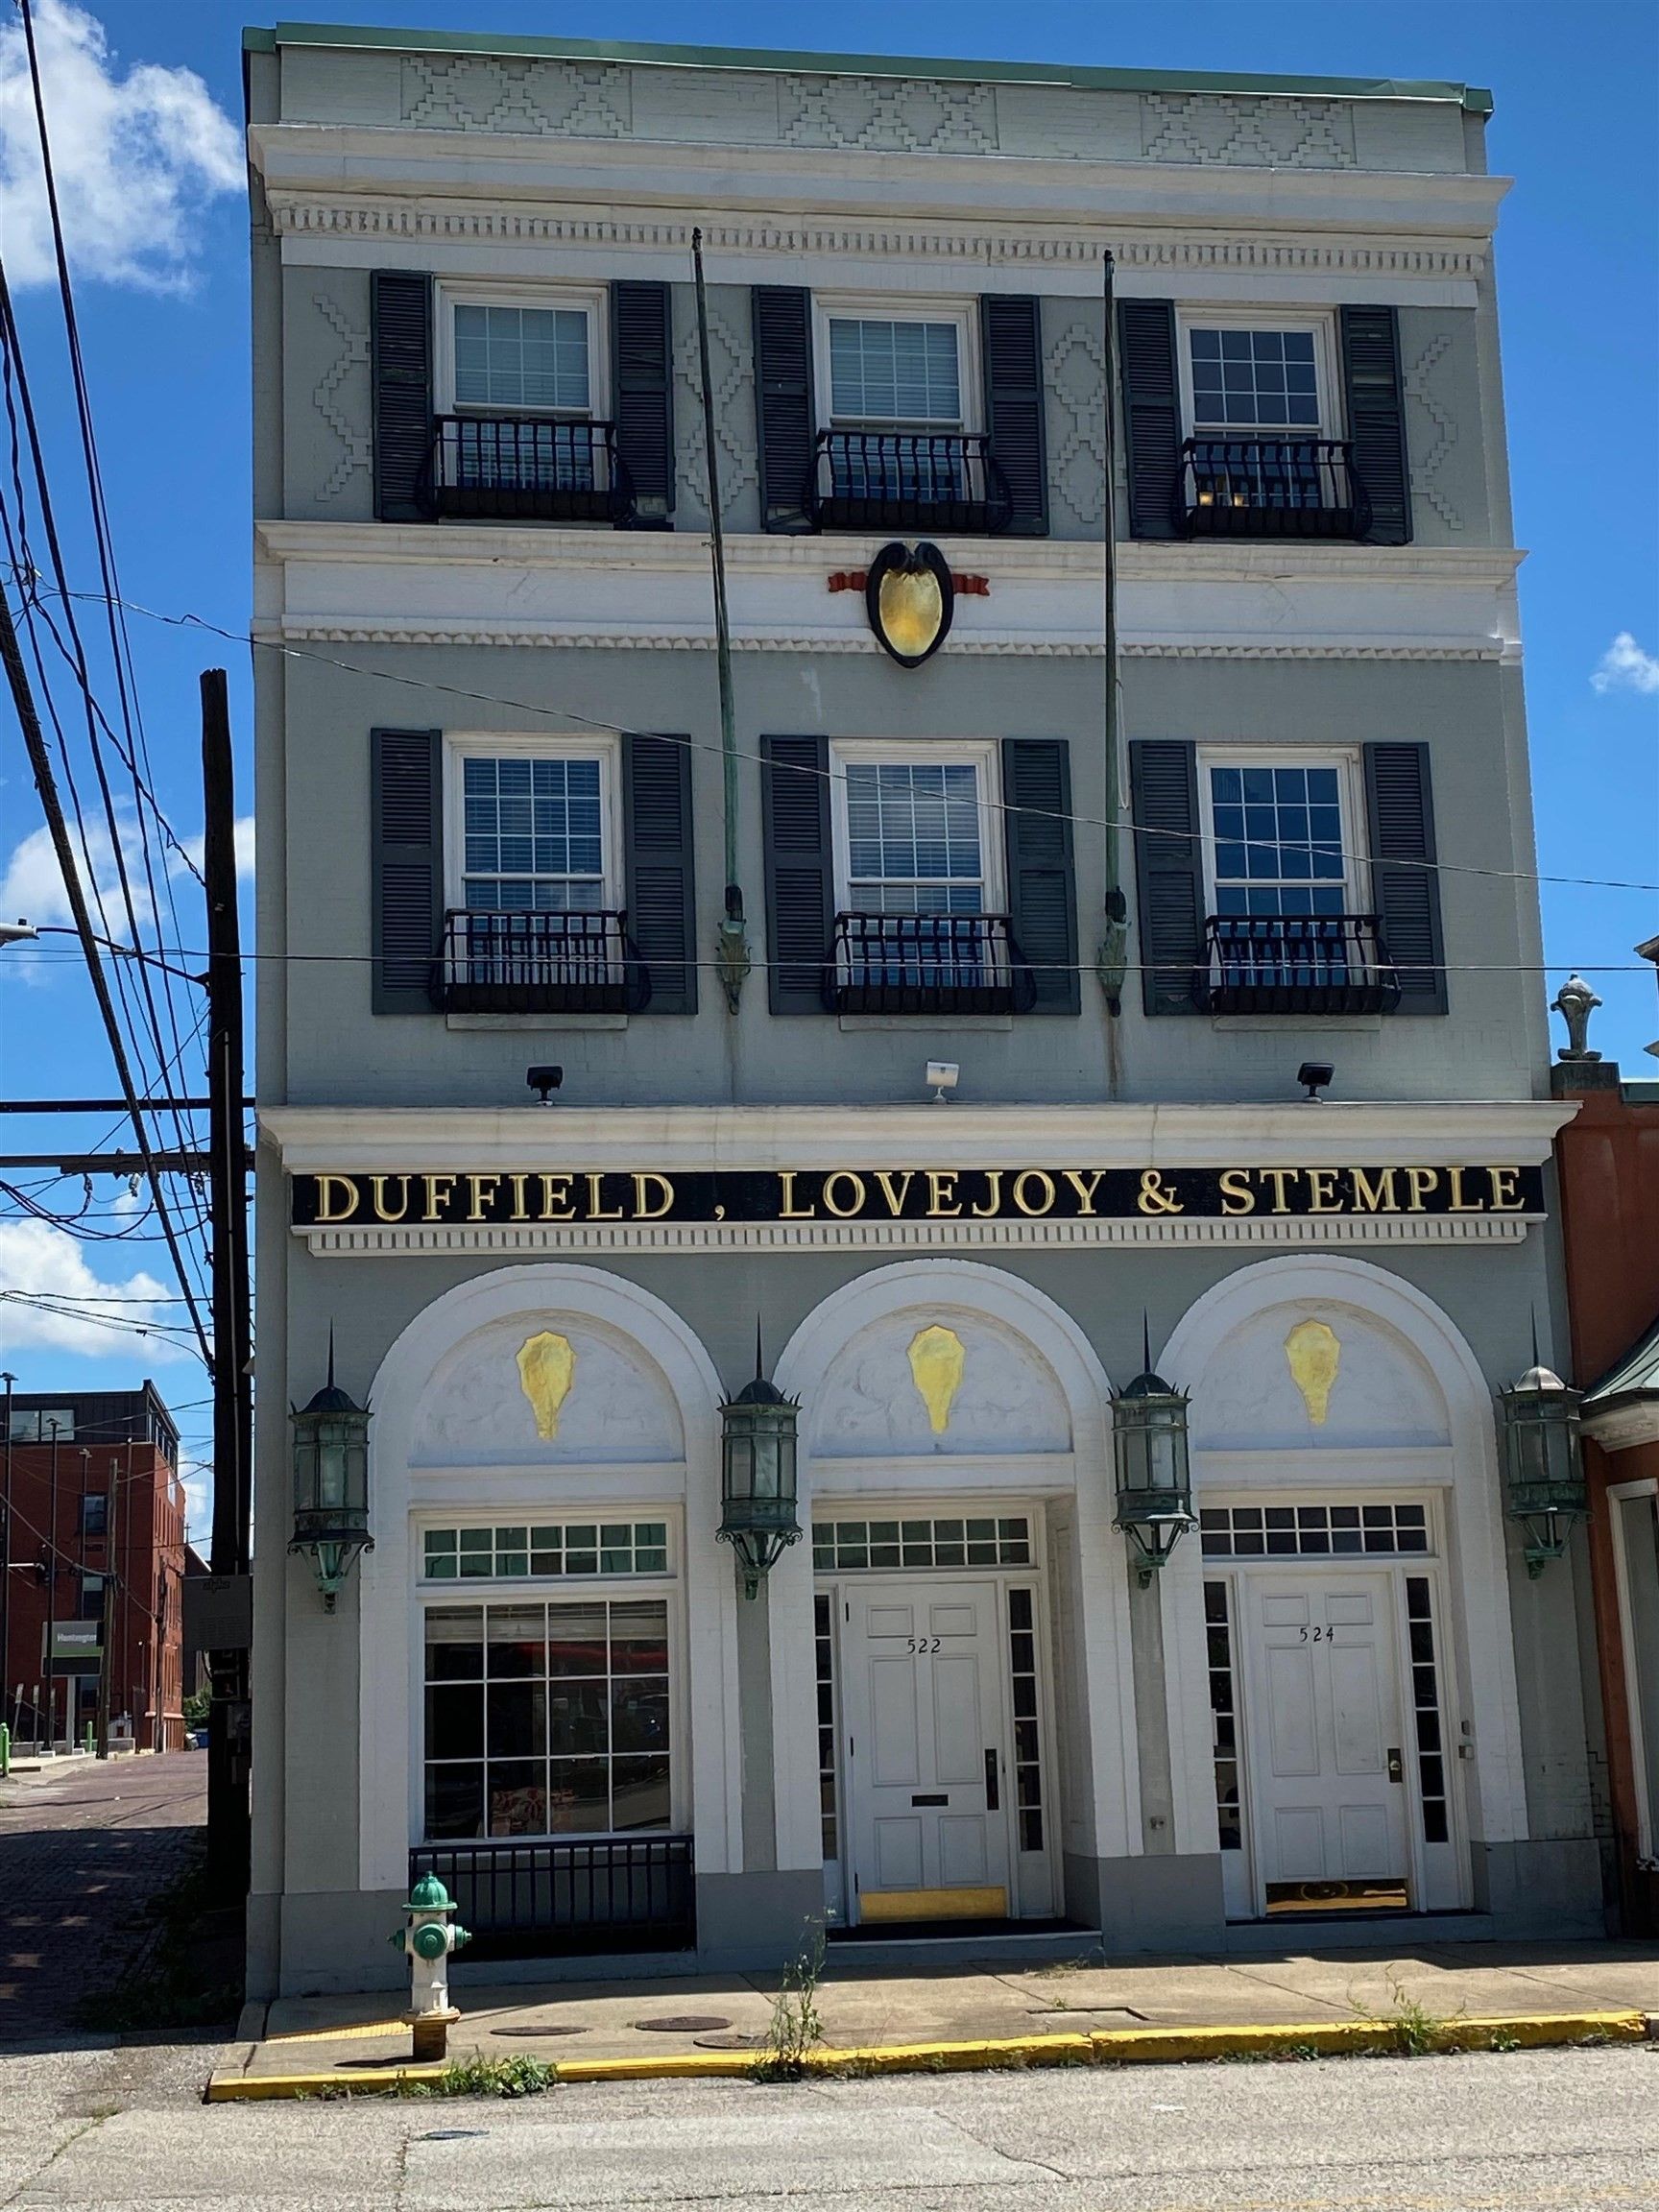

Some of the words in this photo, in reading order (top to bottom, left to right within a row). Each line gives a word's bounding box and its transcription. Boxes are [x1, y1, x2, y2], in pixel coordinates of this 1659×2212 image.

[314, 1173, 675, 1221] DUFFIELD
[778, 1169, 1106, 1217] LOVEJOY
[1137, 1170, 1184, 1214] &
[1219, 1166, 1526, 1214] STEMPLE
[1299, 1626, 1334, 1643] 524
[907, 1638, 941, 1654] 522
